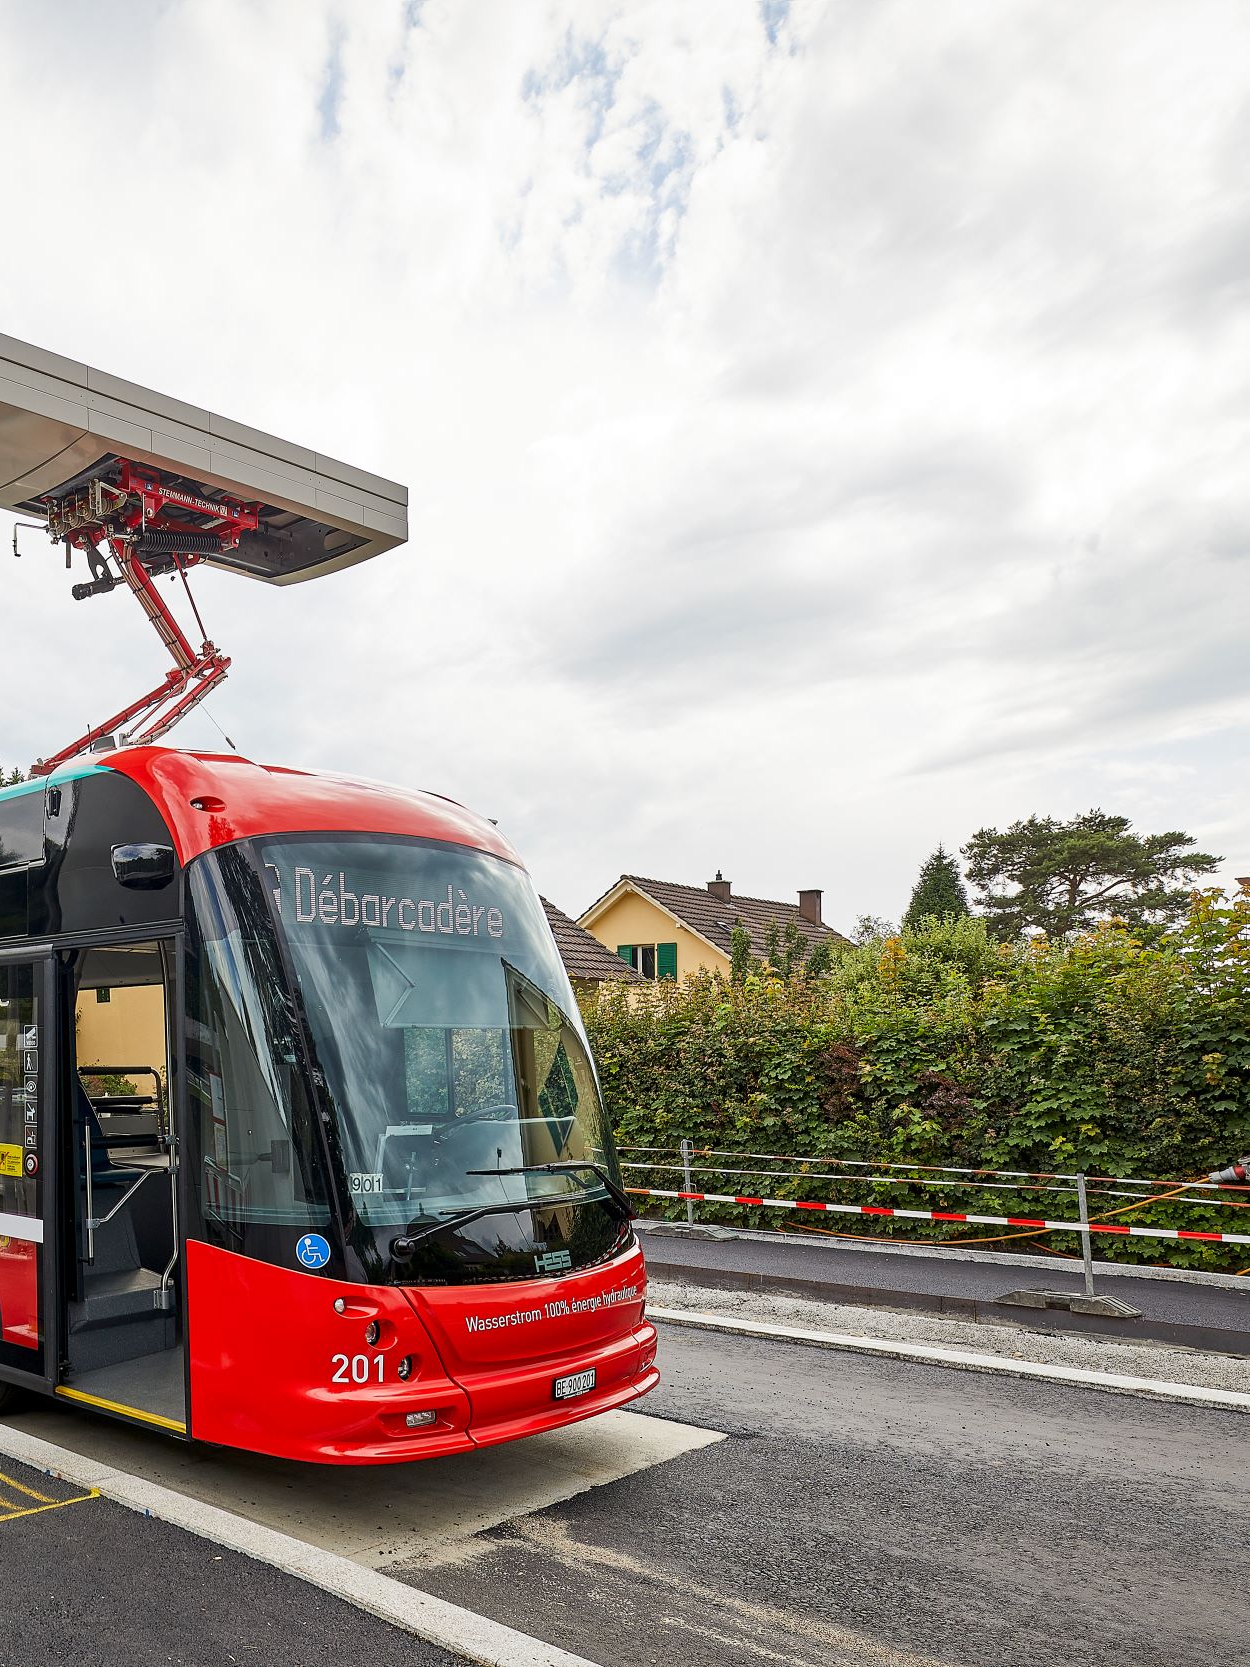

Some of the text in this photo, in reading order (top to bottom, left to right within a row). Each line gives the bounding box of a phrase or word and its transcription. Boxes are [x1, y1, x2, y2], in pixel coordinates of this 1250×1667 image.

[158, 487, 220, 513] STEMMANN-TECHNIK
[294, 866, 504, 939] Débarcadère
[352, 1177, 382, 1193] 901
[533, 1249, 573, 1273] HESS
[465, 1308, 542, 1333] Wasserstrom
[544, 1299, 570, 1319] 100%
[571, 1296, 602, 1313] énergie
[331, 1353, 385, 1384] 201
